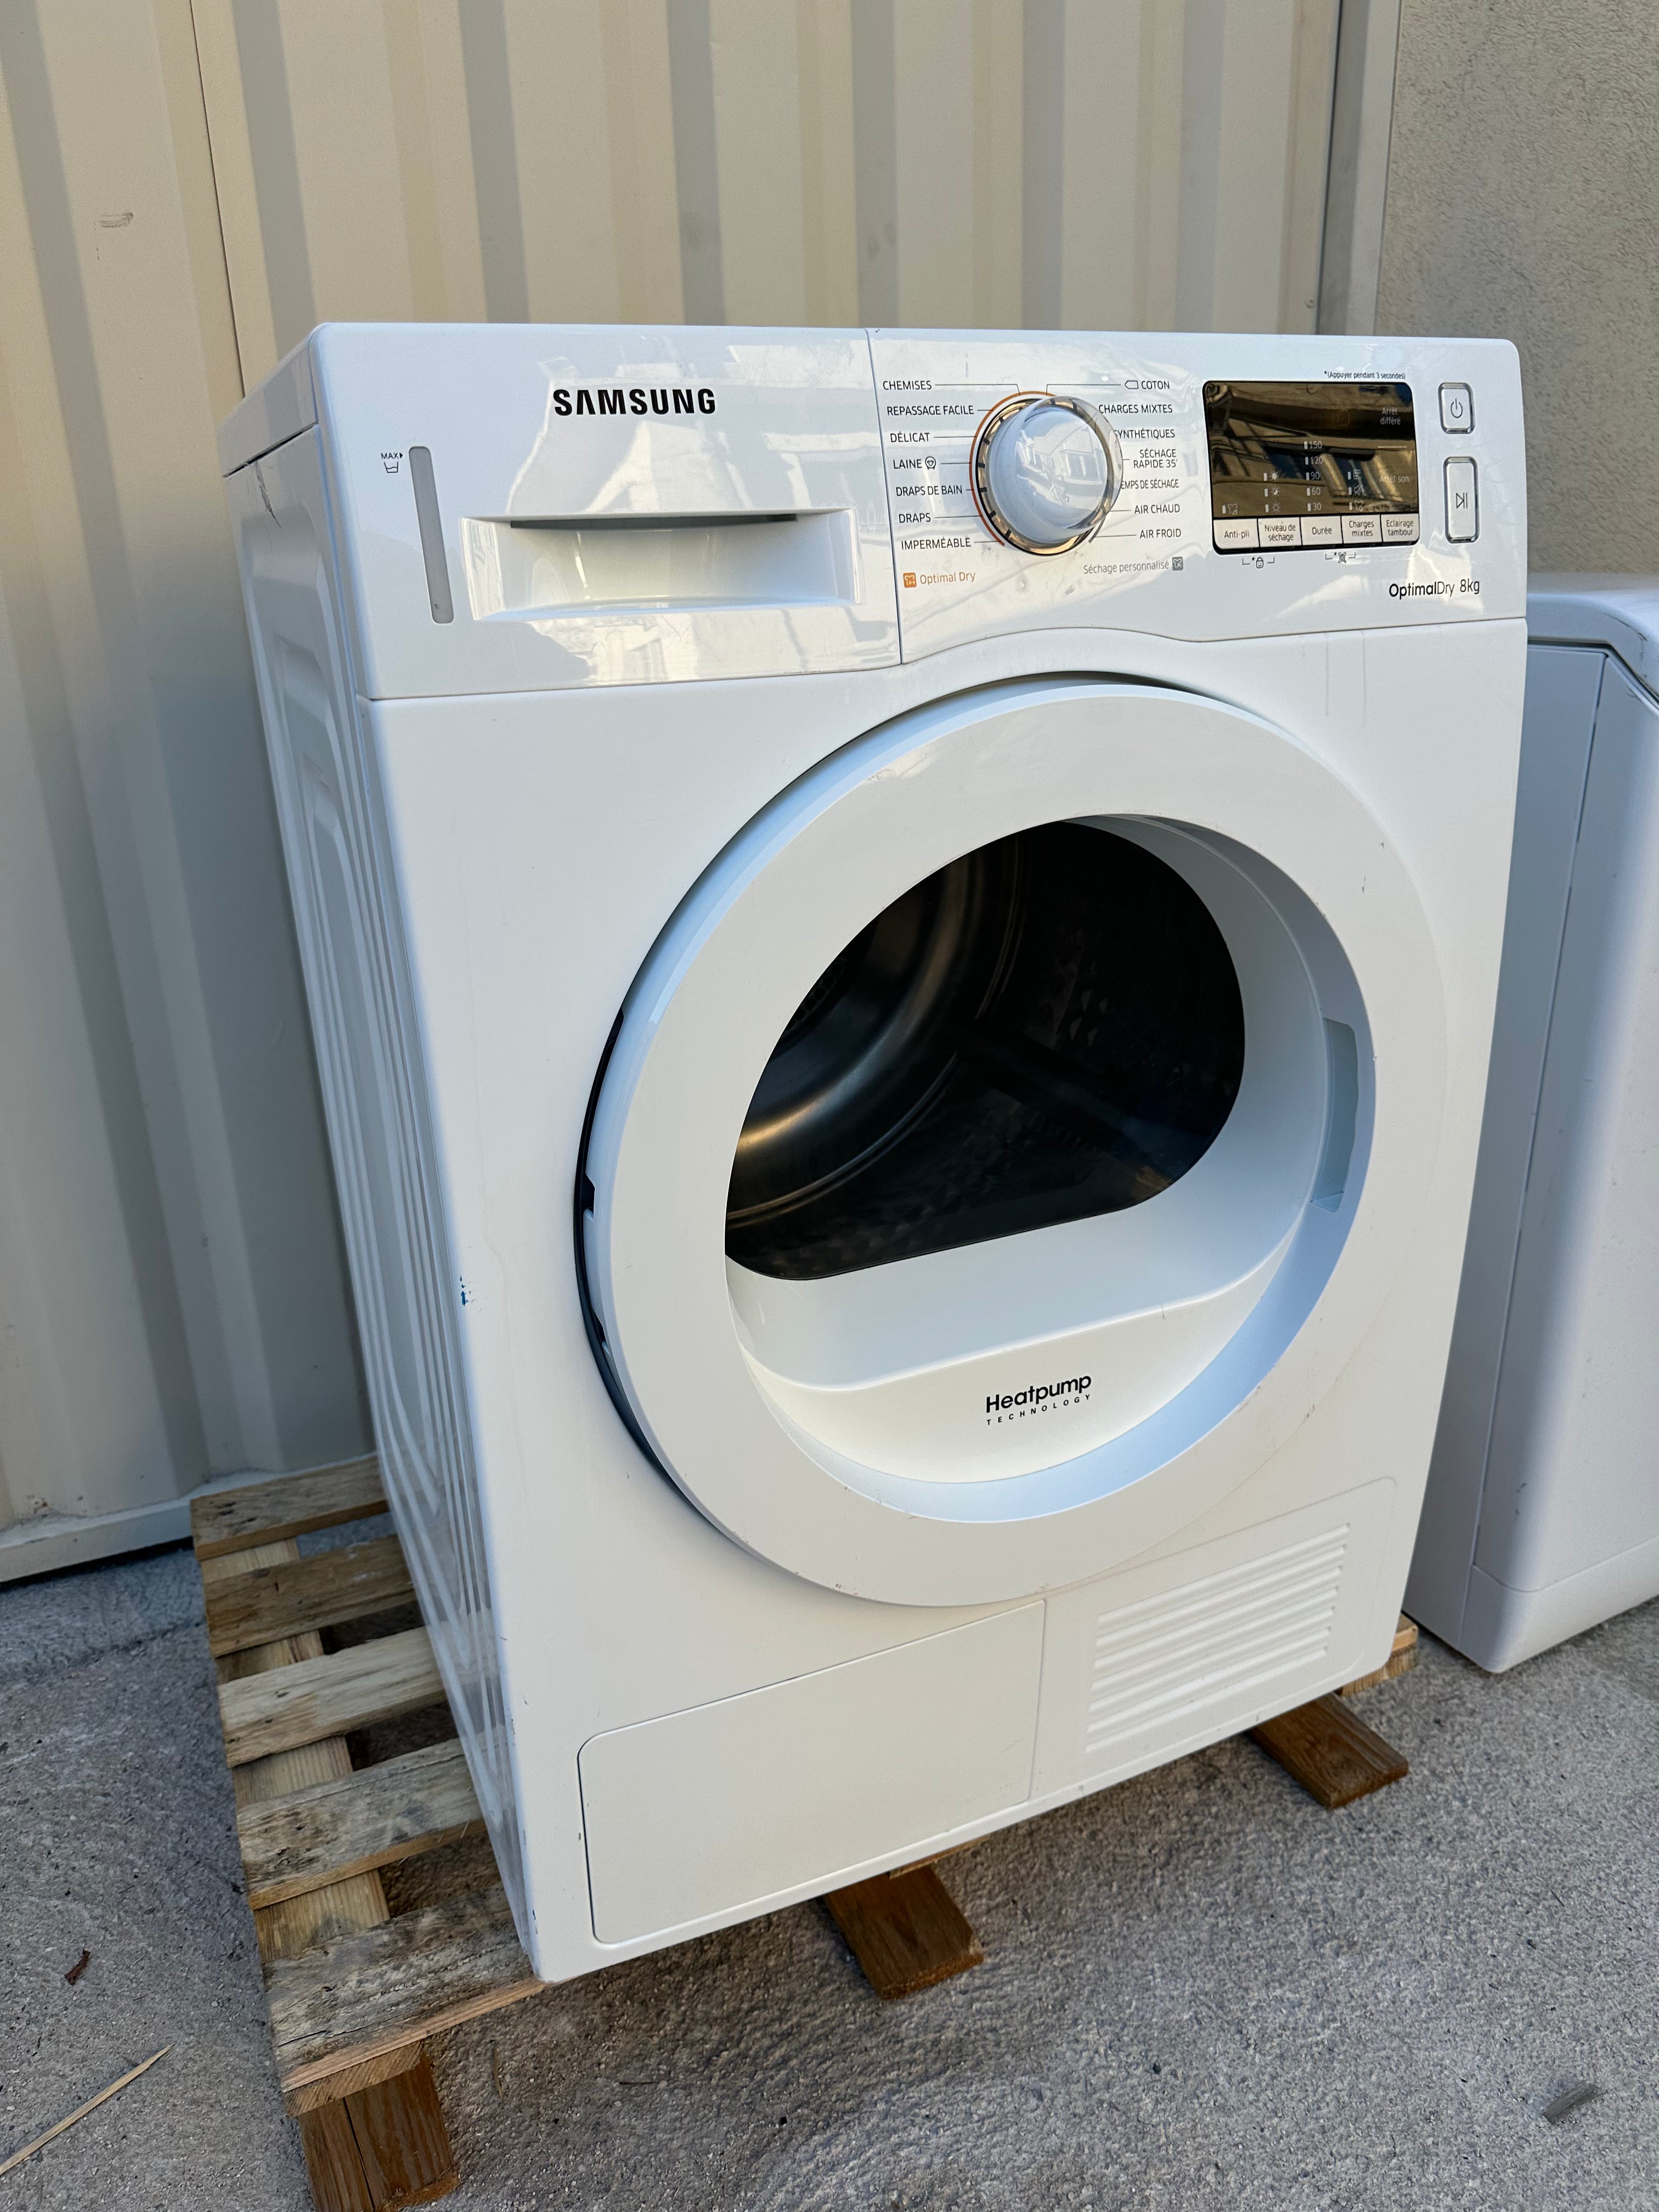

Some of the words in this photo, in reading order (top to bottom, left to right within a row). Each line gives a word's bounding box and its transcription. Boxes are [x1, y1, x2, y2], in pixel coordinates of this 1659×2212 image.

[883, 381, 932, 390] CHEMISES
[1141, 381, 1170, 390] COTON
[554, 388, 716, 415] SAMSUNG
[887, 406, 941, 415] REPASSAGE
[943, 405, 974, 415] FACILE
[1099, 404, 1138, 414] CHARGES
[1142, 404, 1172, 413] MIXTES
[890, 431, 929, 442] DÉLICAT
[1139, 448, 1176, 458] SÉCHAGE
[893, 459, 922, 469] LAINE
[1133, 459, 1163, 469] RAPIDE
[1311, 456, 1323, 465] 120
[1121, 481, 1138, 489] EMPS
[1140, 480, 1148, 489] DE
[1150, 478, 1179, 489] SÉCHAGE
[896, 486, 926, 496] DRAPS
[927, 486, 939, 495] DE
[941, 485, 962, 494] BAIN
[1135, 505, 1148, 514] AIR
[1151, 504, 1180, 514] CHAUD
[899, 513, 931, 523] DRAPS
[1349, 520, 1374, 529] Charges
[1140, 530, 1154, 539] AIR
[1156, 529, 1181, 538] FROID
[1224, 530, 1250, 539] Anti-pli
[1312, 527, 1332, 535] Durée
[1268, 534, 1294, 542] séchage
[901, 537, 971, 550] IMPERMÉABLE
[1084, 565, 1117, 574] Séchage
[1119, 560, 1169, 573] personnalisé
[919, 572, 956, 585] Optimal
[959, 572, 976, 583] Dry
[1389, 581, 1455, 600] OptimalDry
[1460, 578, 1480, 595] 8kg
[986, 1375, 1092, 1413] Heatpump
[986, 1393, 1091, 1426] TECHNOLOGY
